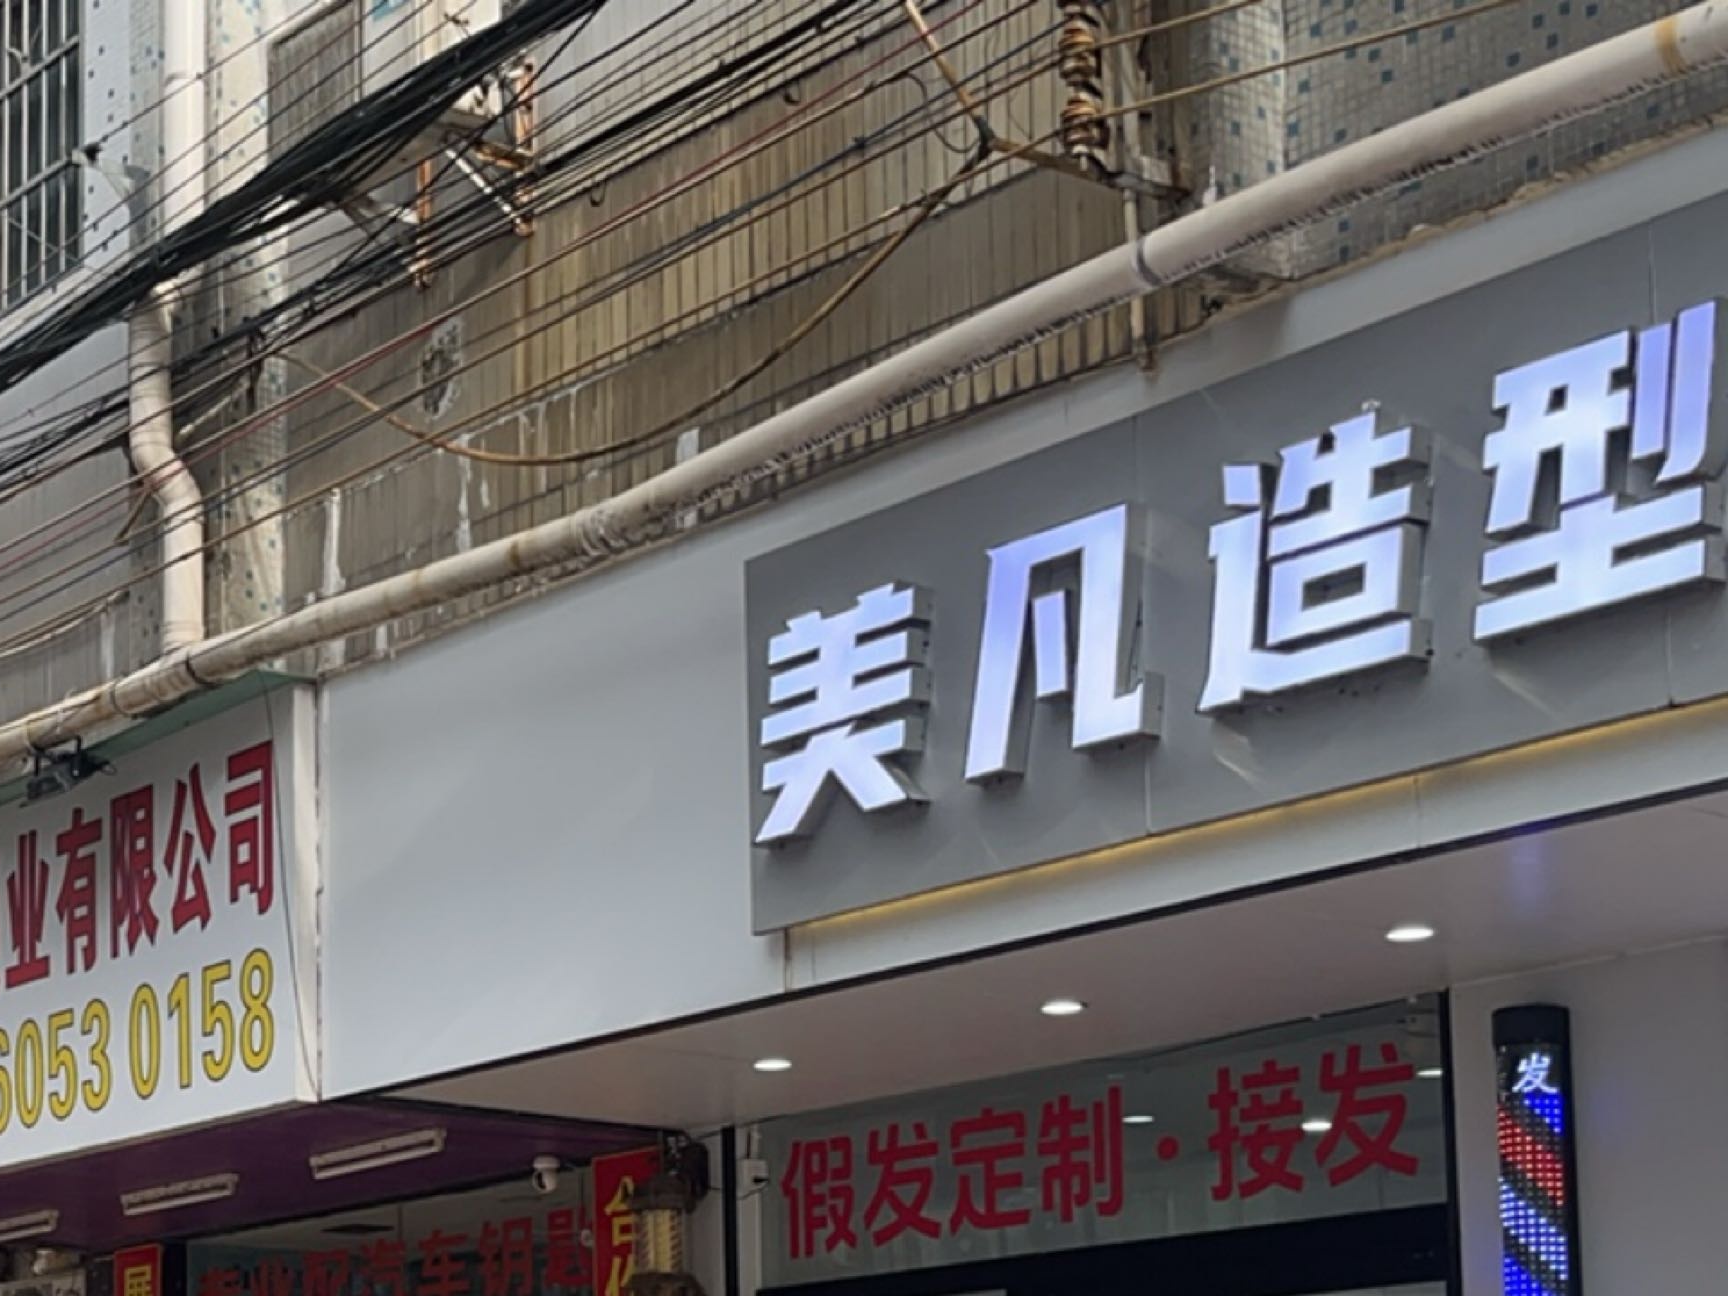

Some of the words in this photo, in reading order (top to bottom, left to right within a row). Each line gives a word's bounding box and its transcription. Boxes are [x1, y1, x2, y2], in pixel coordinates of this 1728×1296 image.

[756, 298, 1716, 844] 美凡造型
[780, 1041, 1422, 1262] 假发定制·接发
